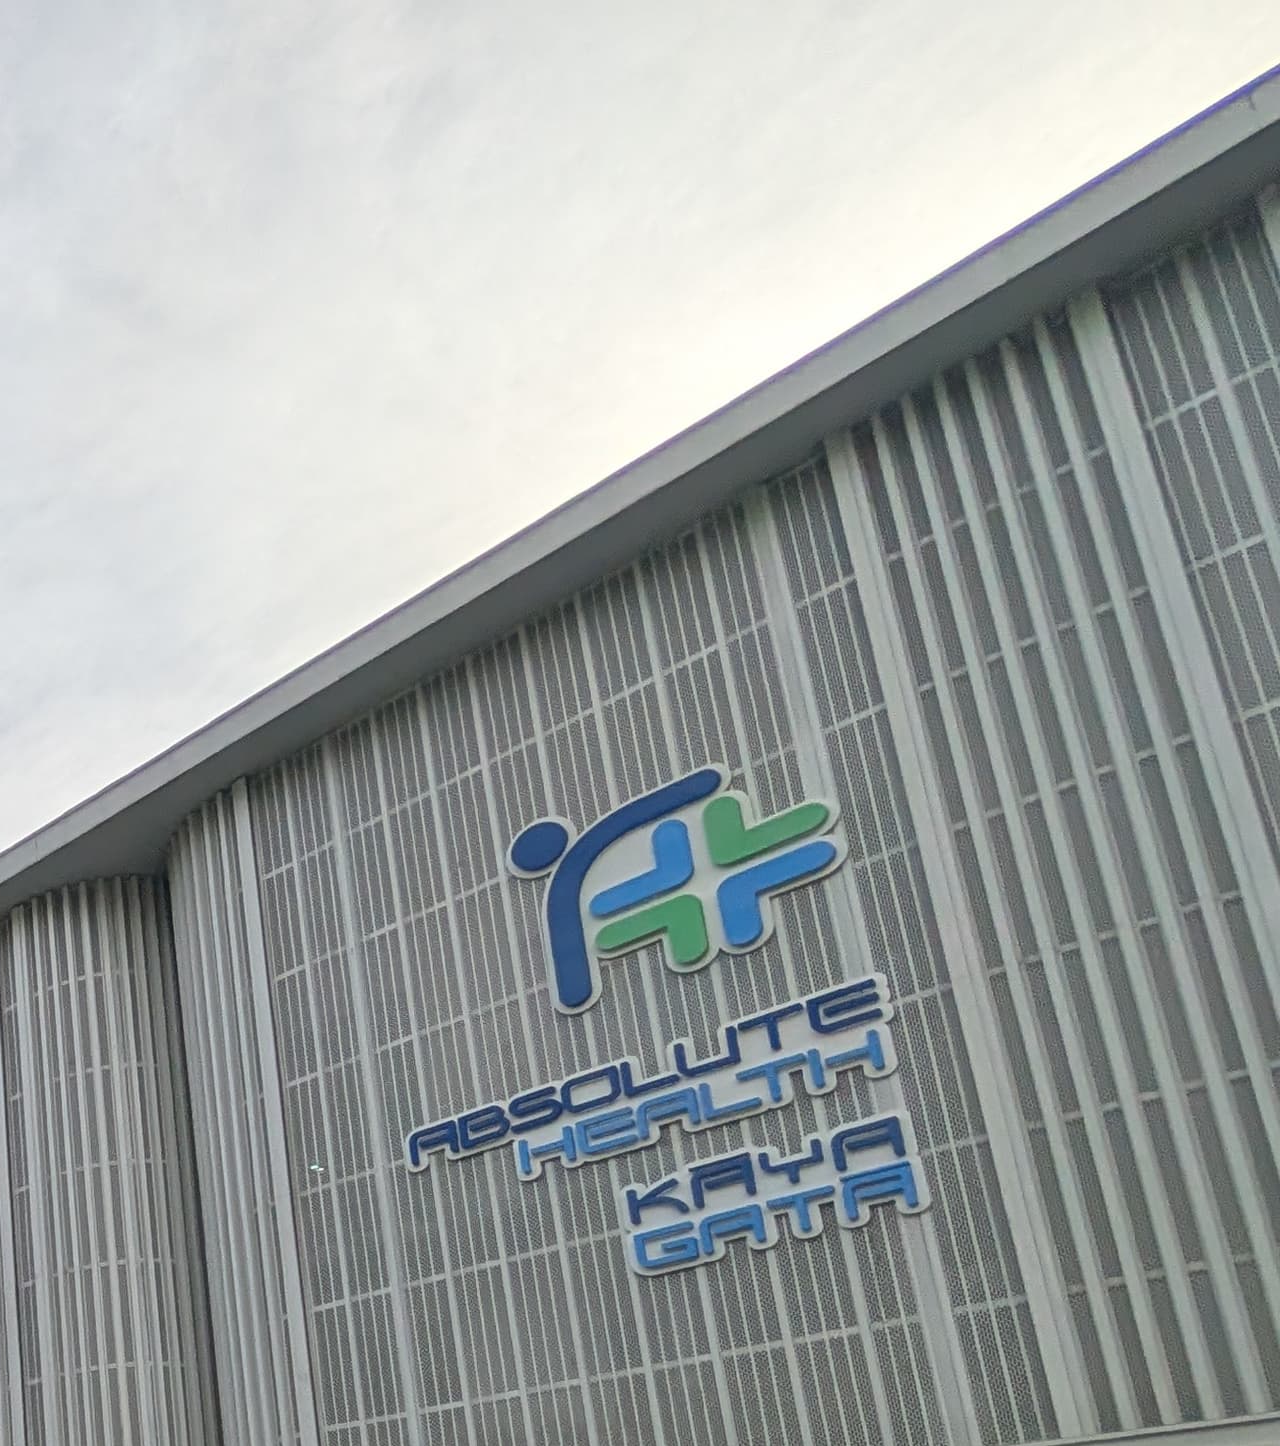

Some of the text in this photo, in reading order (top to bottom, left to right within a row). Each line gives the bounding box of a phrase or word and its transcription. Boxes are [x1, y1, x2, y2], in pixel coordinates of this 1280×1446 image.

[410, 978, 883, 1167] ABSOLUTE
[519, 1029, 886, 1175] HEALTH
[628, 1115, 906, 1225] KAYA
[632, 1160, 919, 1271] GATA
